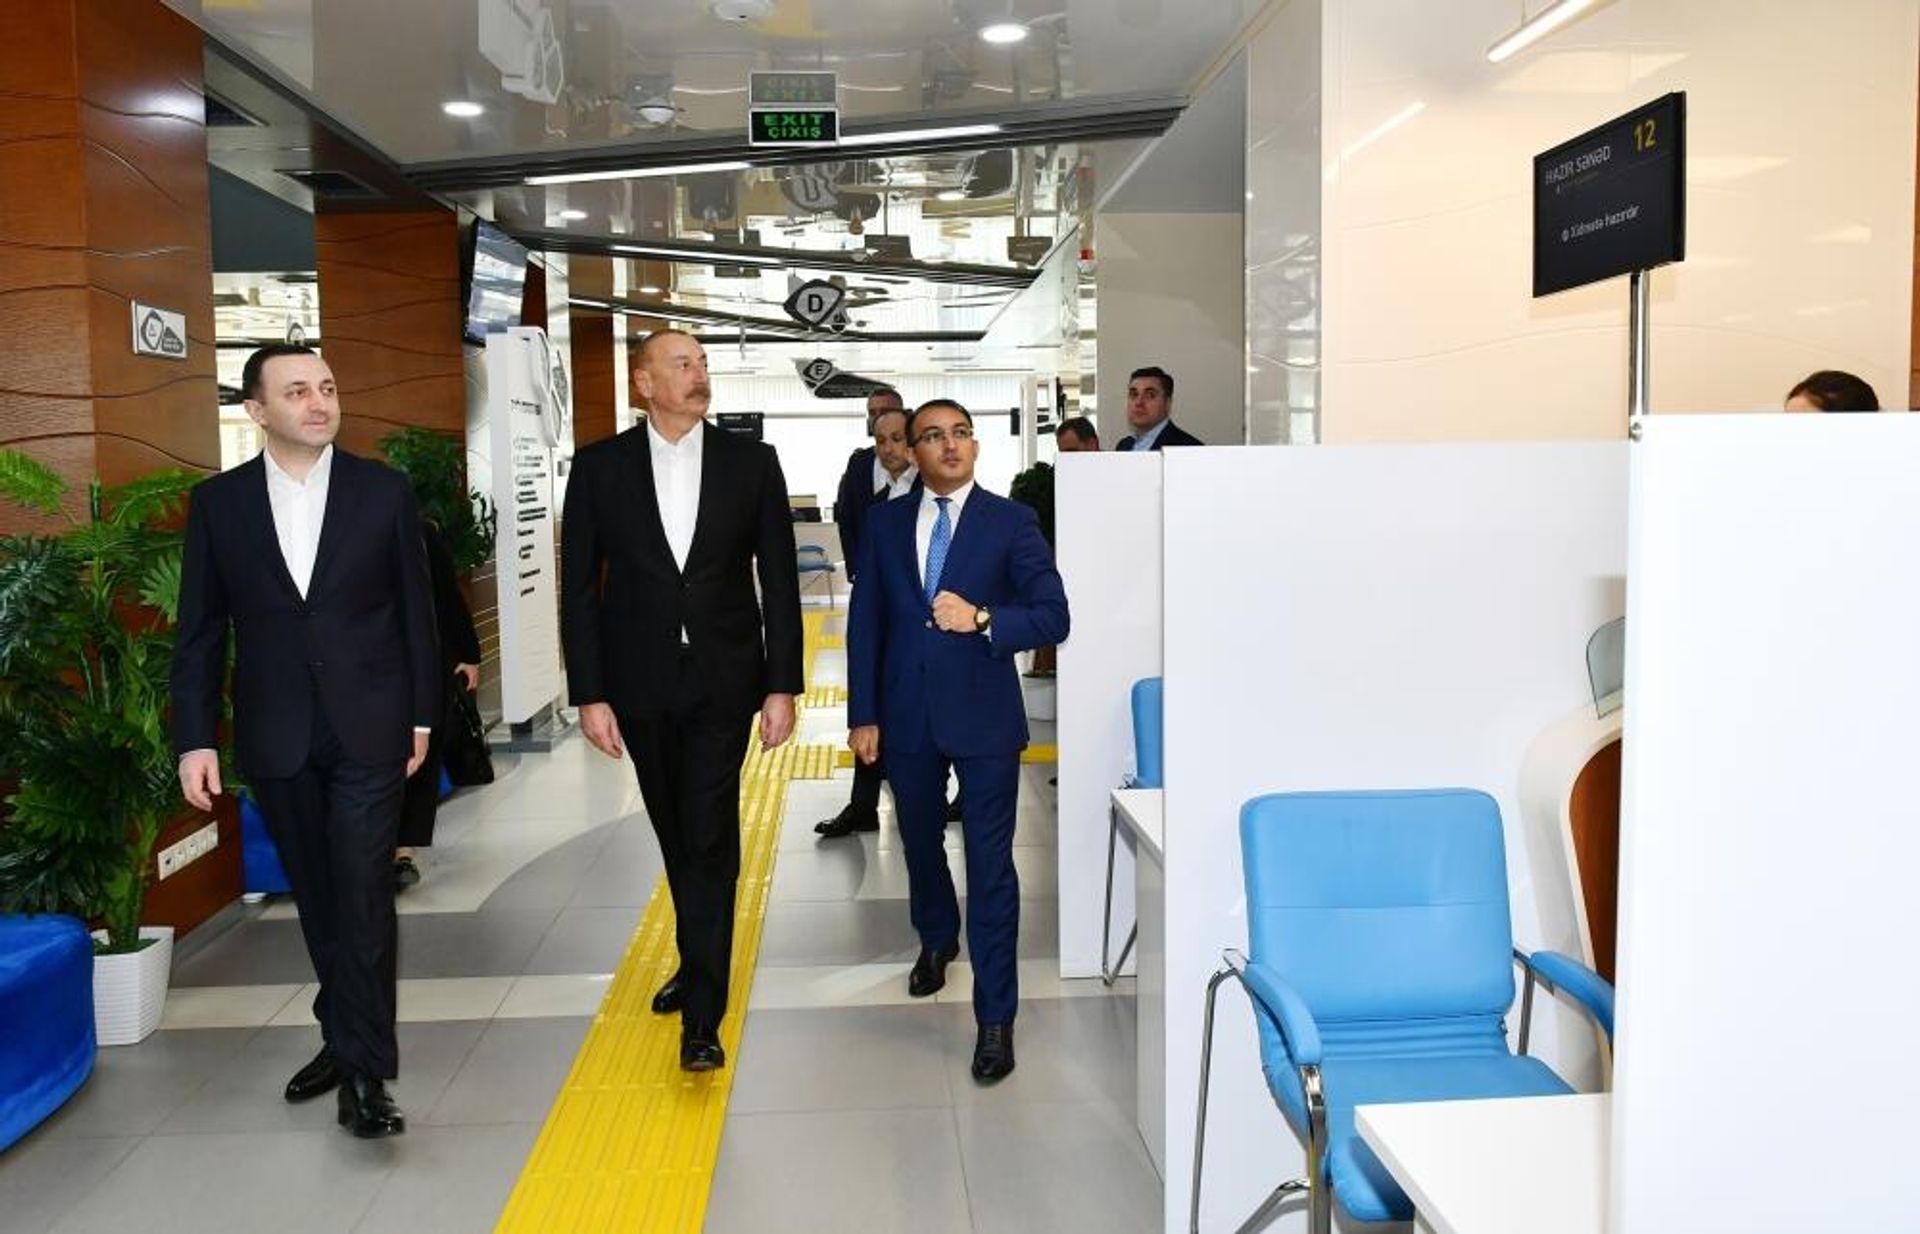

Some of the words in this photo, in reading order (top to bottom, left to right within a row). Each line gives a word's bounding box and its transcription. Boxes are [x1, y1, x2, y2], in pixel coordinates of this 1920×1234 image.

[764, 114, 824, 126] EXIT
[1634, 119, 1656, 151] 12
[808, 294, 823, 313] D
[815, 364, 824, 376] E
